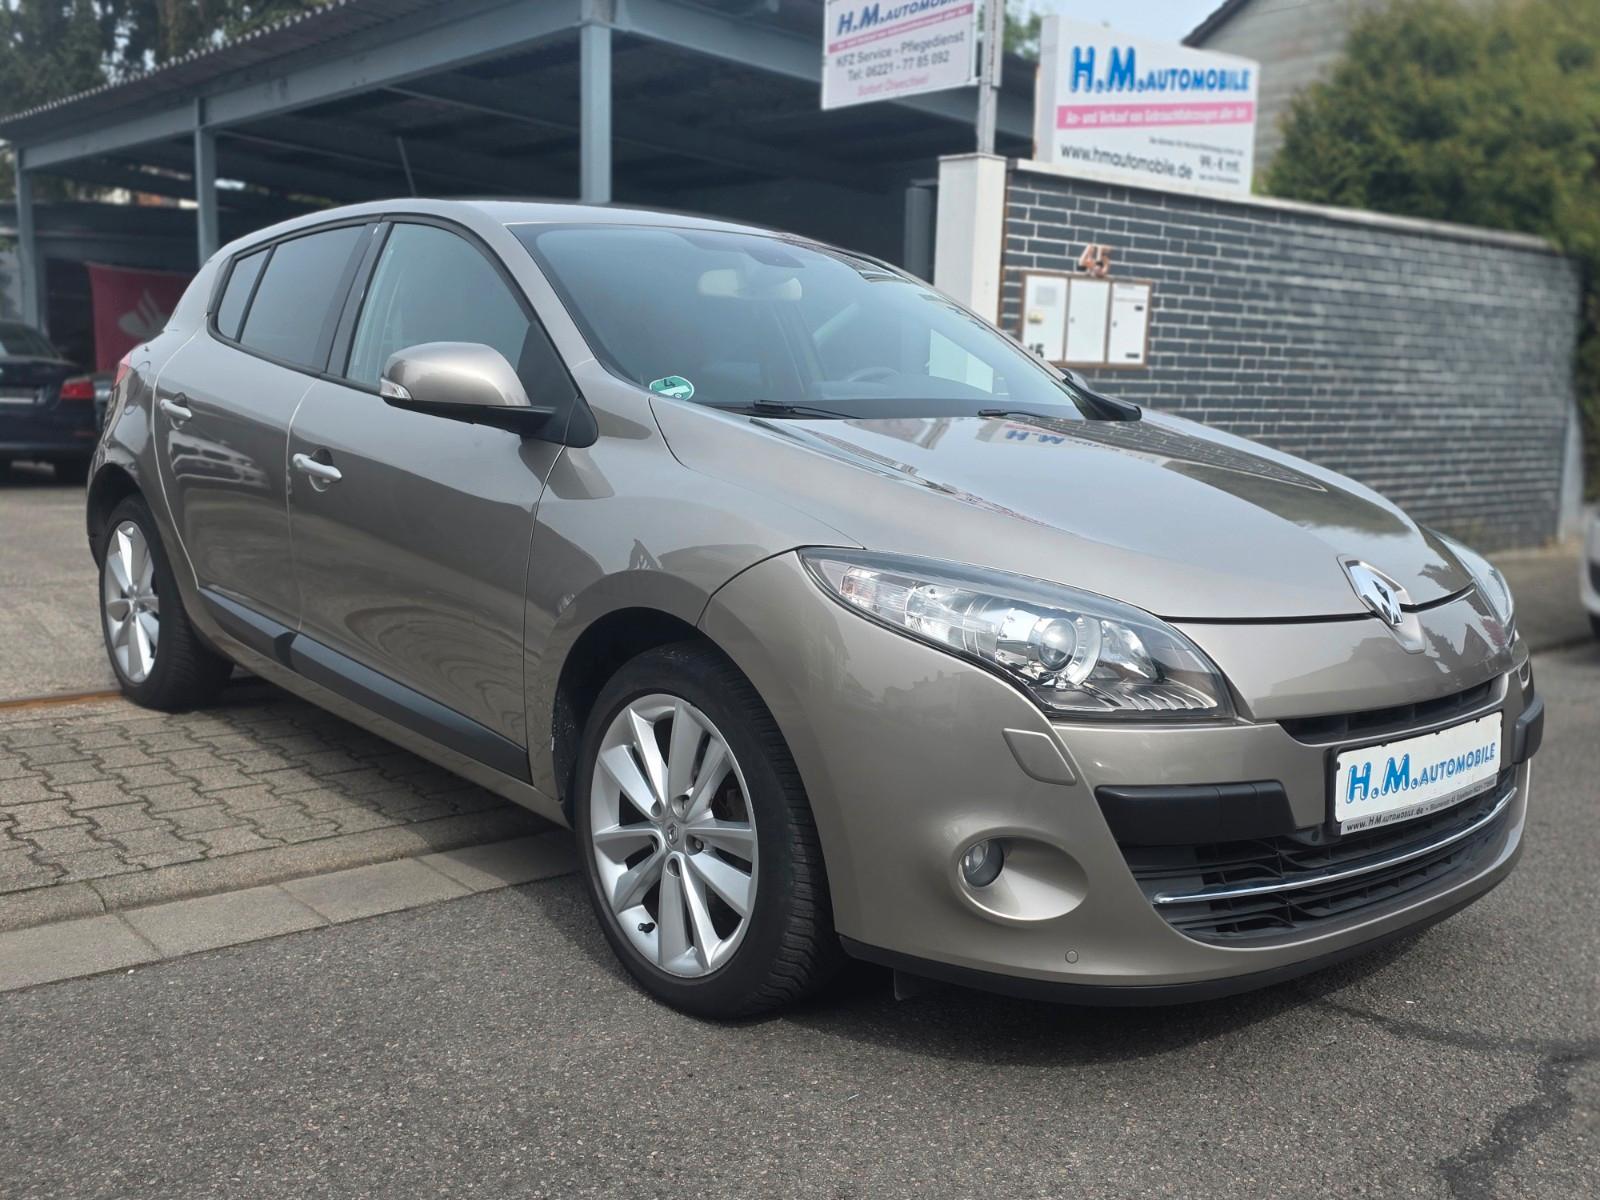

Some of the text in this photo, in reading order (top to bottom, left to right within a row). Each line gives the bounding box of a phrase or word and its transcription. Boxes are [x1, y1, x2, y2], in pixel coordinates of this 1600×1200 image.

[857, 48, 892, 63] Service
[900, 30, 964, 55] Pflegedienst
[902, 57, 914, 70] 77
[1060, 144, 1192, 179] www.hmautomobile.de
[1078, 243, 1113, 278] 45
[1345, 742, 1496, 804] H.M.AUTOMOBILE
